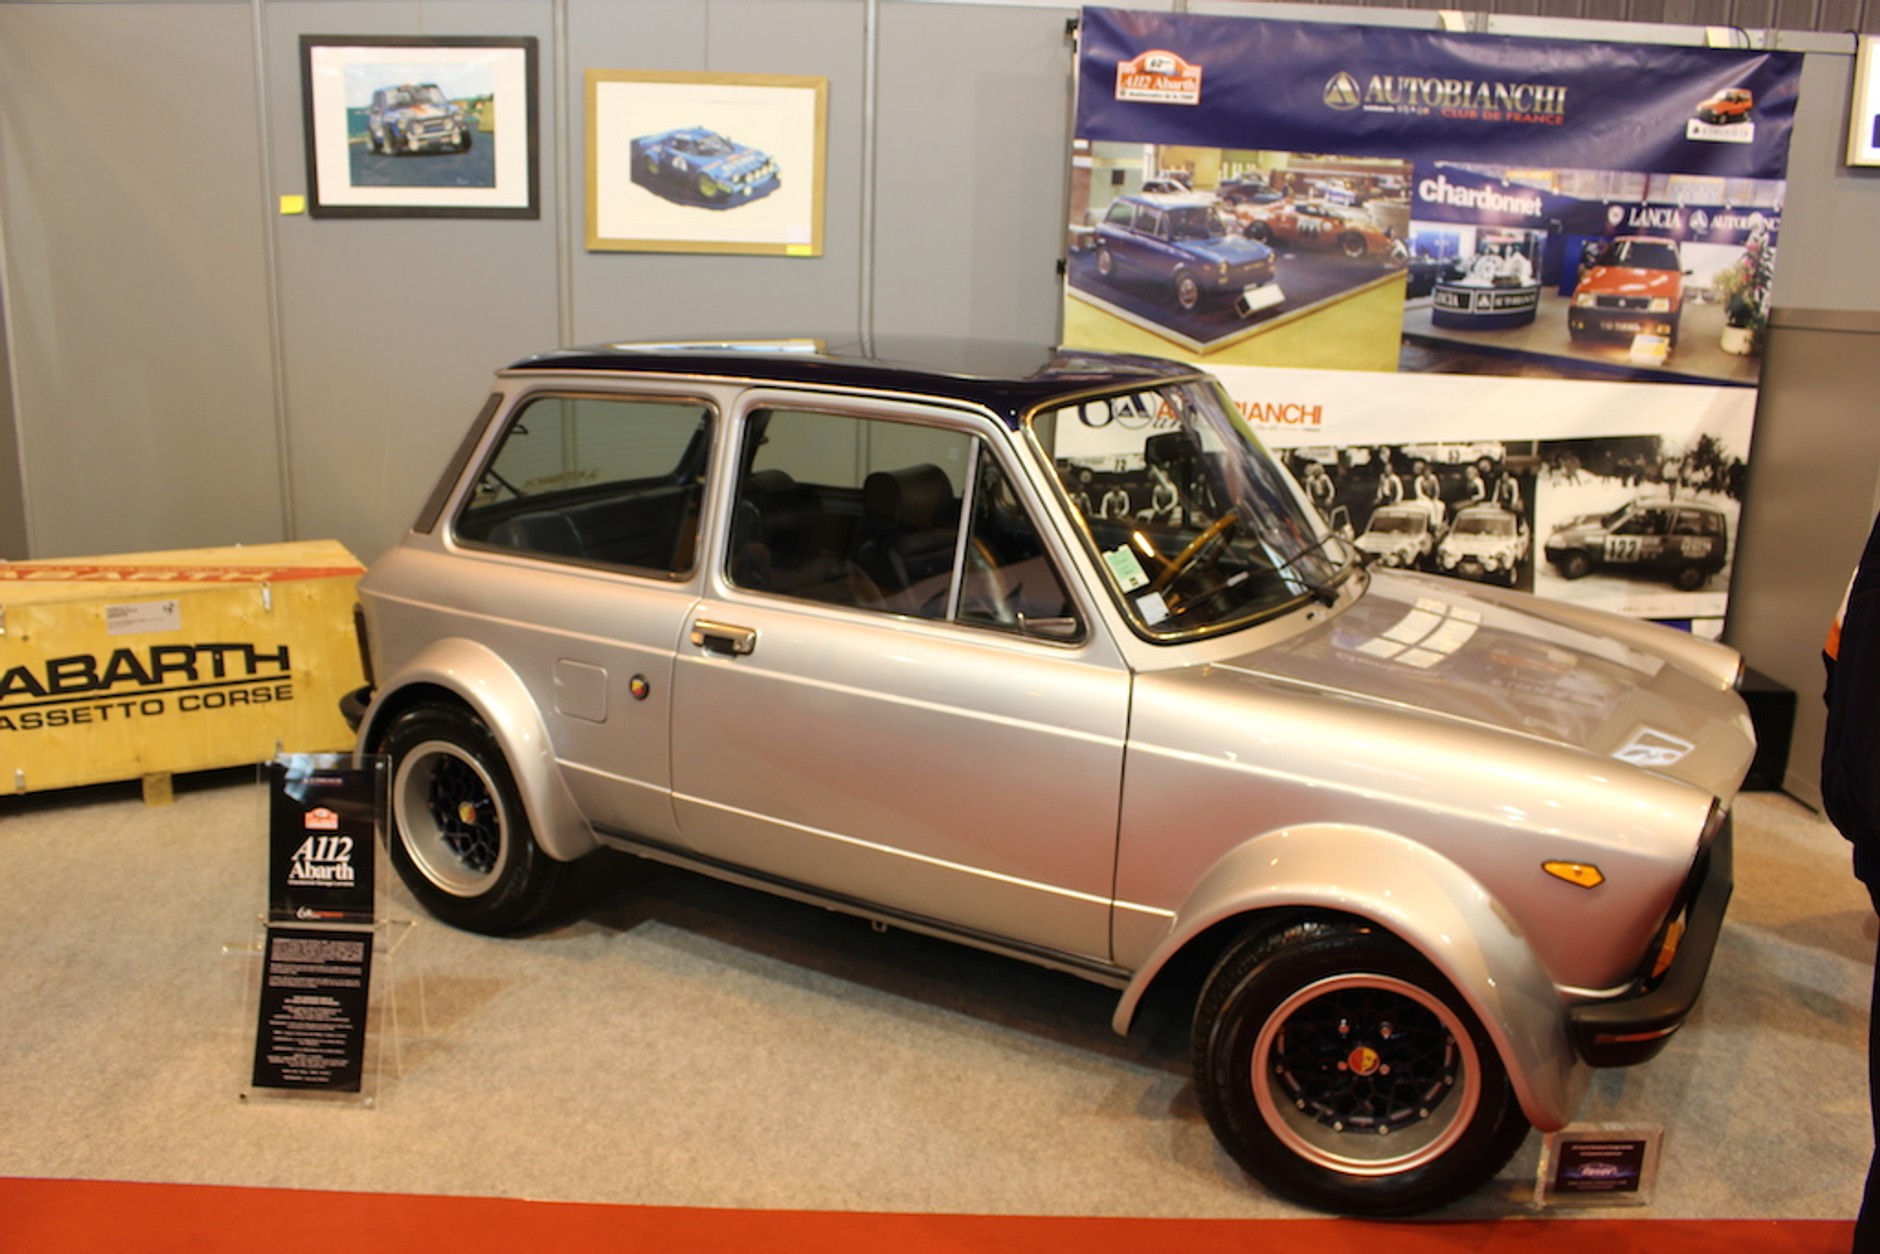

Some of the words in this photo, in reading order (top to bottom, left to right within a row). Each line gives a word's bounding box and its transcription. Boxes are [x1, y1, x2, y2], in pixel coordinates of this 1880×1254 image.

[1364, 74, 1568, 115] AUTOBIANCHI
[1440, 107, 1478, 120] CLUB
[1482, 110, 1502, 121] DE
[1506, 111, 1564, 126] FRANCE
[1419, 175, 1542, 217] chardonnet
[1628, 207, 1681, 229] LANCIA
[1610, 541, 1638, 560] 122
[0, 643, 290, 701] ABARTH
[179, 684, 294, 712] CORSE
[291, 836, 353, 862] A112
[289, 860, 354, 881] Abarth
